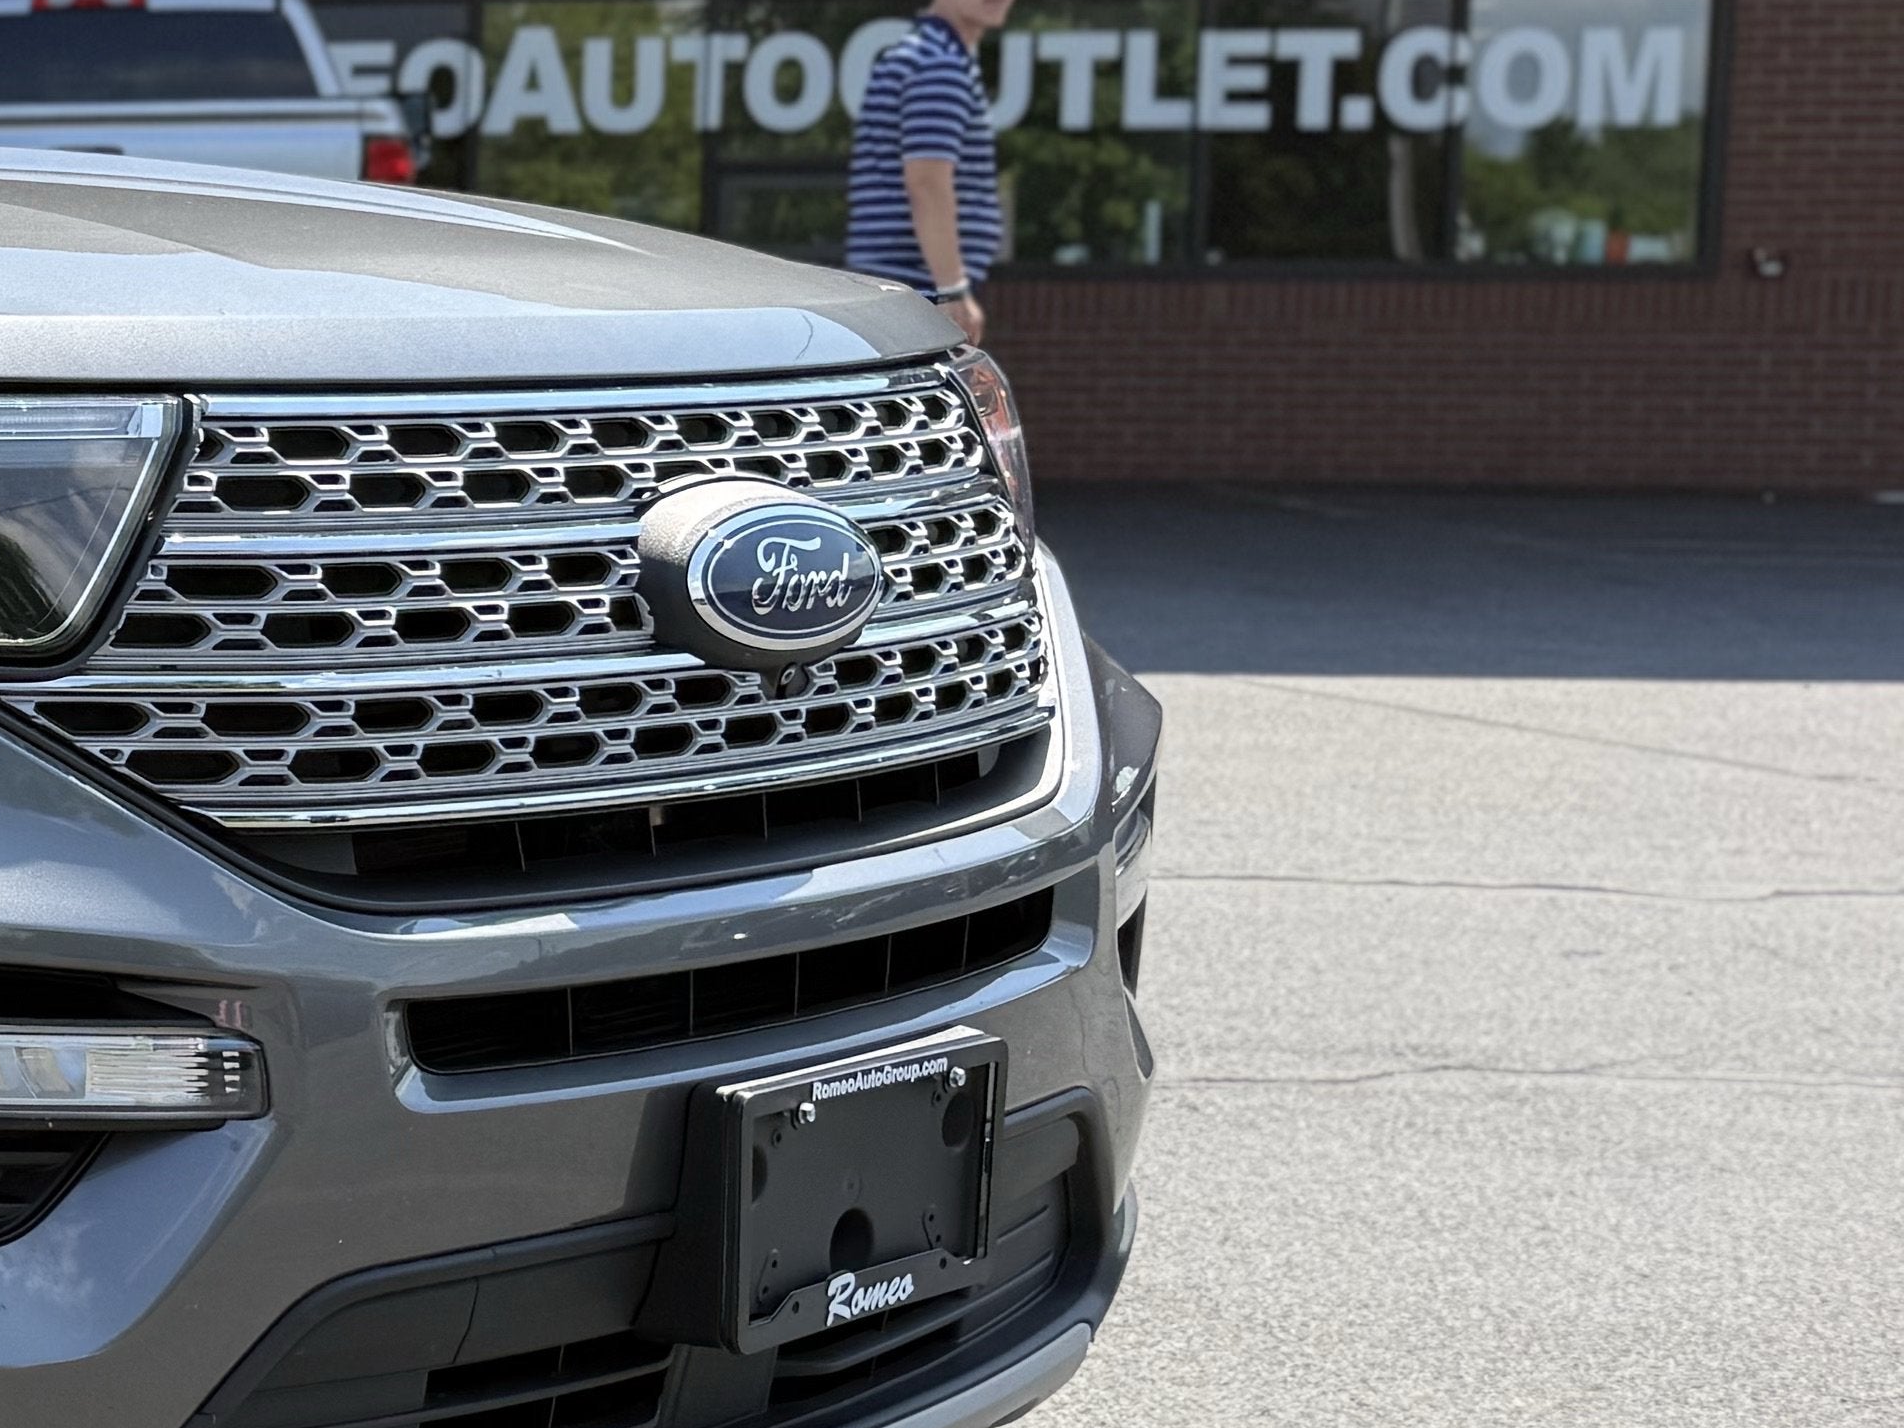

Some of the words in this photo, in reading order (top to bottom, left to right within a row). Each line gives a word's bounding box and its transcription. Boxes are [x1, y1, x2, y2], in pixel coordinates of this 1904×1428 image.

[751, 536, 852, 615] Ford
[812, 1057, 948, 1101] RomeoAutoGroup.com
[826, 1272, 914, 1326] Romeo
